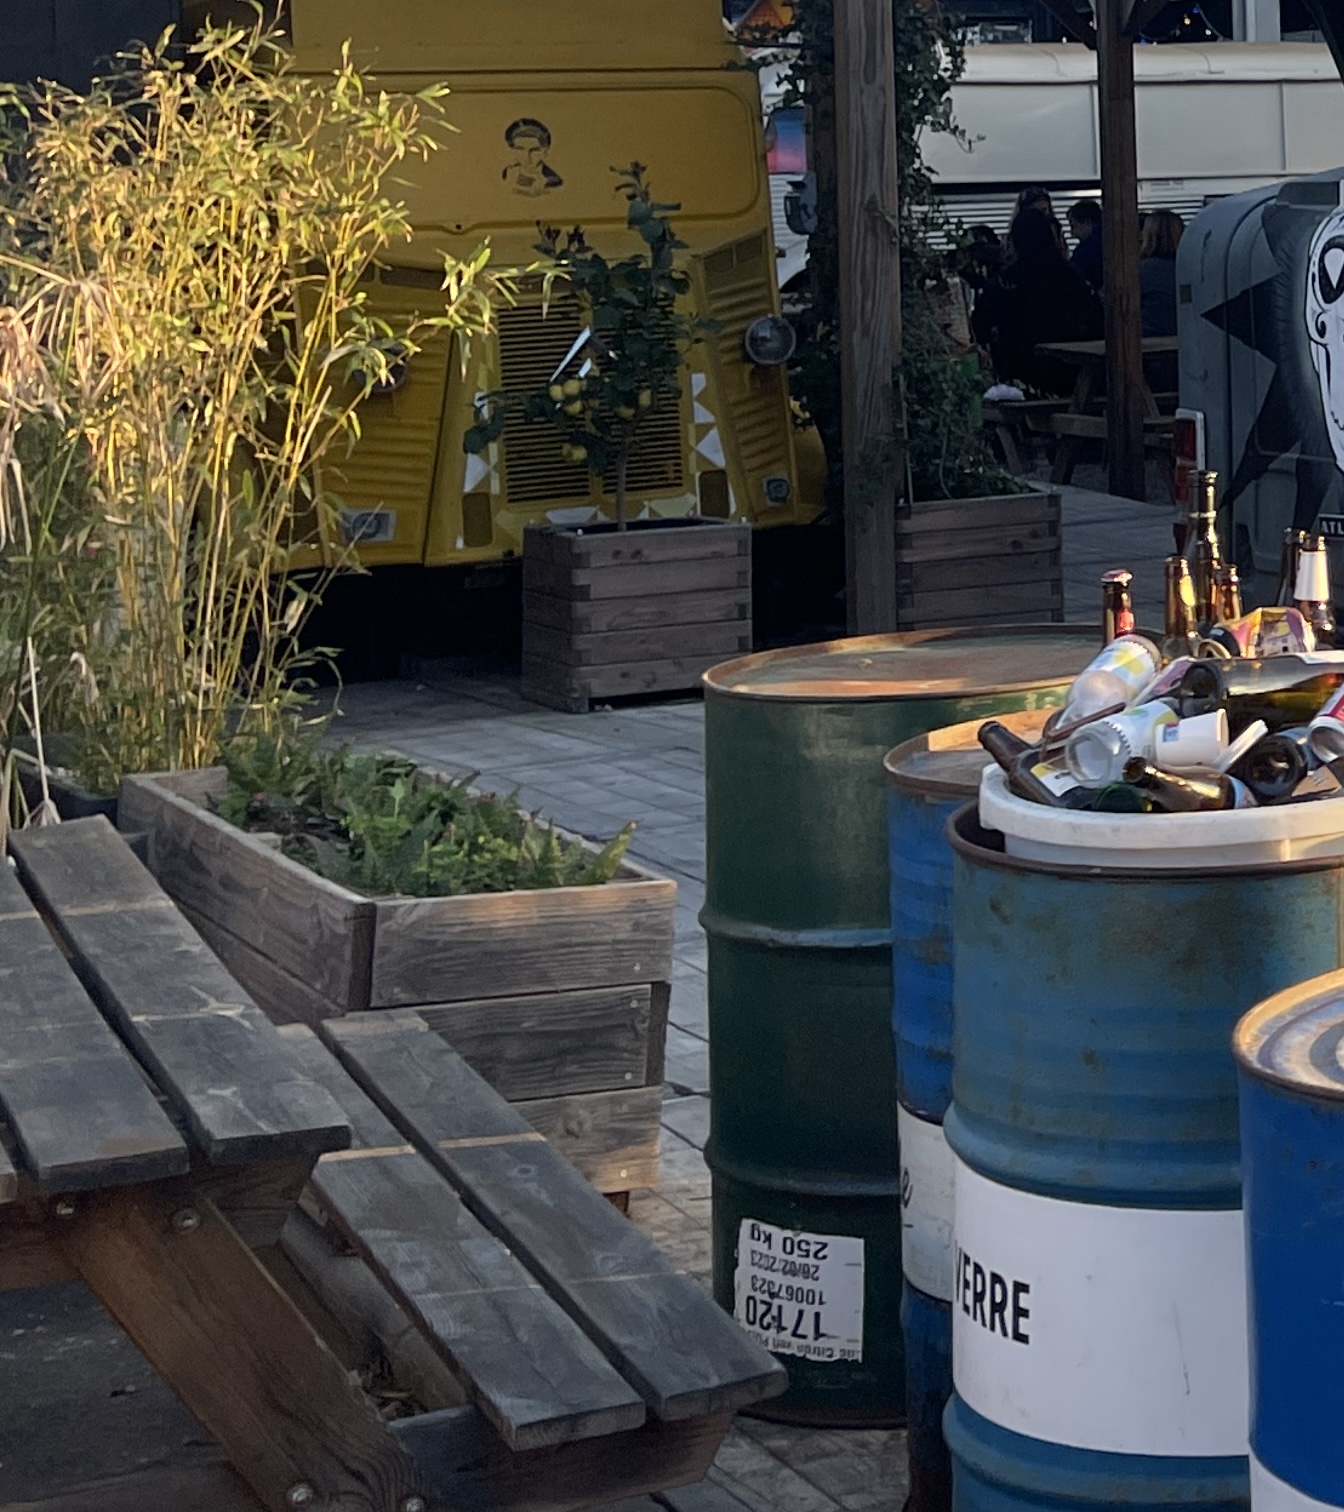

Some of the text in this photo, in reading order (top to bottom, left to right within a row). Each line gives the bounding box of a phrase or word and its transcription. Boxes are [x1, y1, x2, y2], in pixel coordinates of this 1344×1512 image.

[750, 1222, 829, 1261] 250 kg
[954, 1239, 1031, 1346] VERRE
[745, 1295, 829, 1341] 17120
